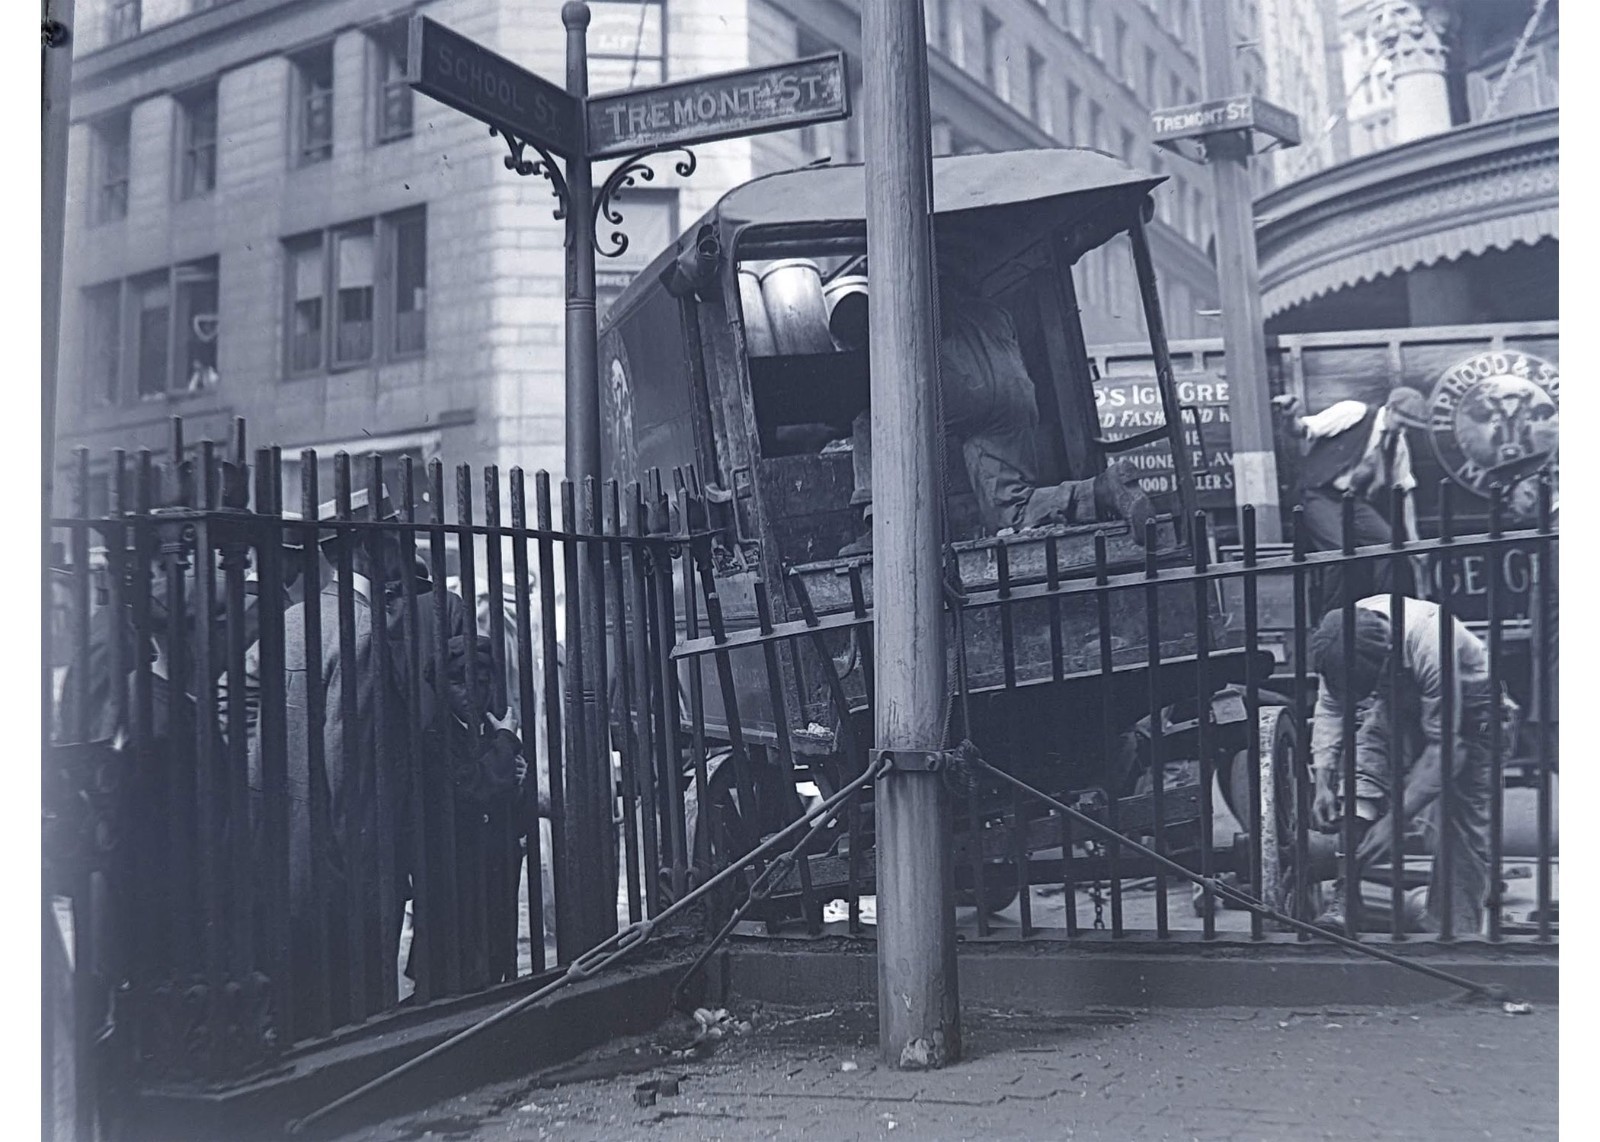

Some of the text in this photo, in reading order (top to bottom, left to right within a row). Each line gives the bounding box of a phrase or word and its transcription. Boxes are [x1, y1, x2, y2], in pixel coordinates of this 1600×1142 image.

[439, 44, 524, 113] SCHOOL
[605, 85, 760, 140] TREMONT
[1152, 107, 1225, 133] TREMONT
